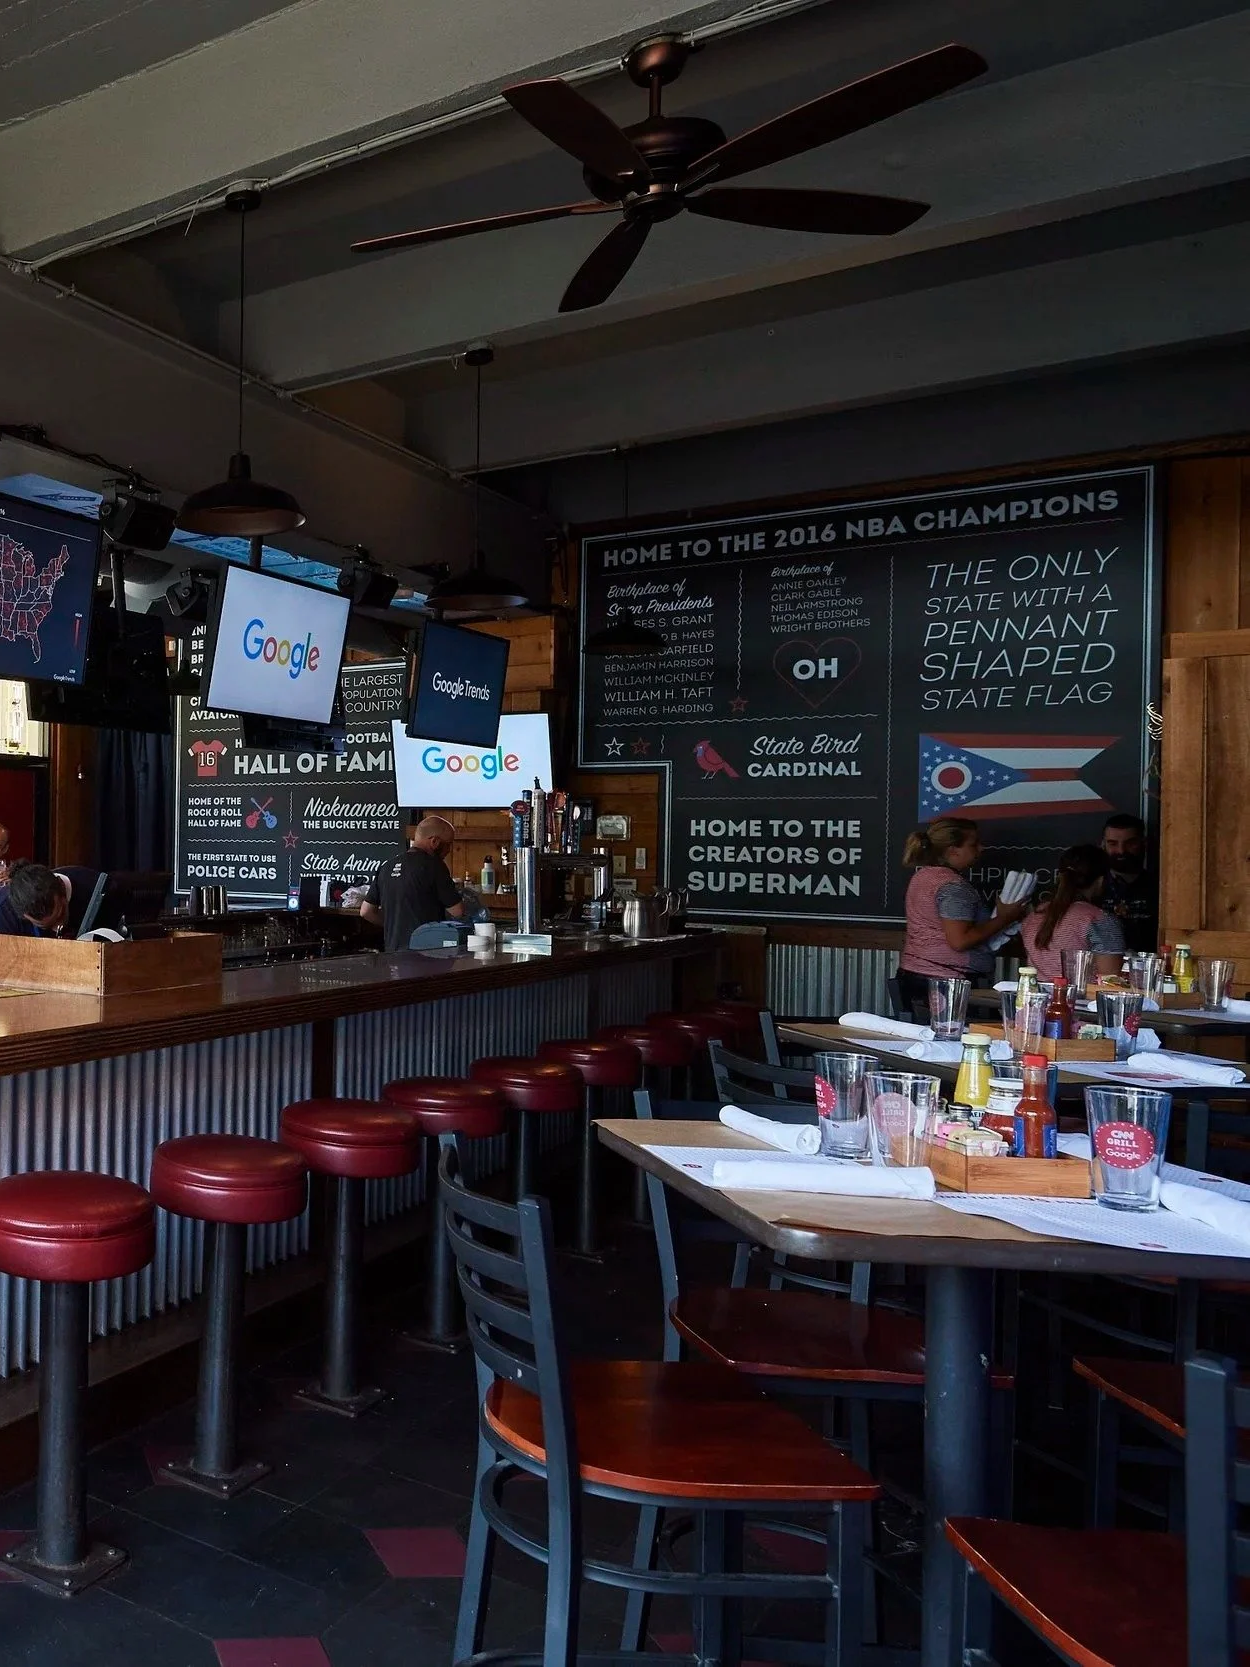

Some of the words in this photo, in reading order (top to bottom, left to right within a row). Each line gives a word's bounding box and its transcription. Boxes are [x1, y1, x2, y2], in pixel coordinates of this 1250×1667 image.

[603, 543, 672, 567] HOME
[678, 539, 711, 559] TO
[718, 531, 766, 554] THE
[774, 523, 837, 548] 2016
[845, 515, 907, 540] NBA
[913, 490, 1119, 532] CHAMPIONS
[771, 565, 821, 577] Birthplace
[823, 561, 834, 576] of
[927, 558, 997, 588] THE
[1008, 546, 1120, 581] ONLY
[607, 582, 670, 599] Birthplace
[672, 578, 686, 597] of
[771, 581, 803, 591] ANNIE
[806, 576, 847, 588] OAKLEY
[771, 592, 805, 602] CLARK
[807, 588, 842, 599] GABLE
[924, 592, 1004, 616] STATE
[1012, 585, 1085, 608] WITH
[1091, 583, 1113, 602] A
[646, 595, 714, 613] Presidents
[771, 603, 794, 612] NEIL
[795, 597, 863, 611] ARMSTRONG
[672, 614, 714, 626] GRANT
[771, 612, 814, 623] THOMAS
[817, 608, 858, 619] EDISON
[770, 623, 811, 634] WRIGHT
[814, 618, 871, 630] BROTHERS
[923, 609, 1119, 647] PENNANT
[682, 630, 715, 640] HAYES
[243, 618, 320, 679] Google
[604, 662, 656, 673] BENJAMIN
[659, 658, 714, 669] HARRISON
[792, 657, 838, 680] OH
[919, 643, 1116, 682] SHAPED
[353, 674, 403, 687] LARGEST
[432, 671, 464, 700] Google
[464, 680, 490, 701] Trends
[604, 676, 652, 687] WILLIAM
[655, 671, 715, 684] MCKINLEY
[604, 689, 661, 702] WILLIAM
[681, 687, 714, 699] TAFT
[921, 686, 1016, 711] STATE
[1025, 681, 1113, 706] FLAG
[345, 700, 403, 713] COUNTRY
[603, 706, 647, 717] WARREN
[662, 703, 714, 714] HARDING
[750, 735, 805, 756] State
[810, 732, 862, 754] Bird
[199, 751, 215, 767] 16
[234, 754, 290, 775] HALL
[296, 752, 329, 773] OF
[422, 745, 519, 780] Google
[747, 761, 862, 778] CARDINAL
[188, 797, 211, 805] HOME
[213, 797, 225, 805] OF
[226, 797, 242, 805] THE
[188, 808, 211, 817] ROCK
[213, 808, 219, 817] &
[221, 808, 242, 817] ROLL
[188, 819, 207, 827] HALL
[208, 819, 219, 827] OF
[220, 819, 242, 827] FAME
[303, 820, 320, 829] THE
[322, 820, 368, 829] BUCKEYE
[370, 820, 400, 829] STATE
[690, 819, 762, 837] HOME
[769, 819, 804, 837] TO
[810, 819, 861, 838] THE
[225, 854, 248, 862] STATE
[301, 853, 340, 871] State
[343, 853, 388, 872] Anim
[688, 845, 820, 864] CREATORS
[827, 847, 862, 865] OF
[187, 865, 235, 878] POLICE
[239, 866, 277, 880] CARS
[687, 871, 861, 897] SUPERMAN
[1106, 1137, 1139, 1148] GRILL
[1110, 1130, 1135, 1140] CNN
[1105, 1148, 1141, 1160] Google
